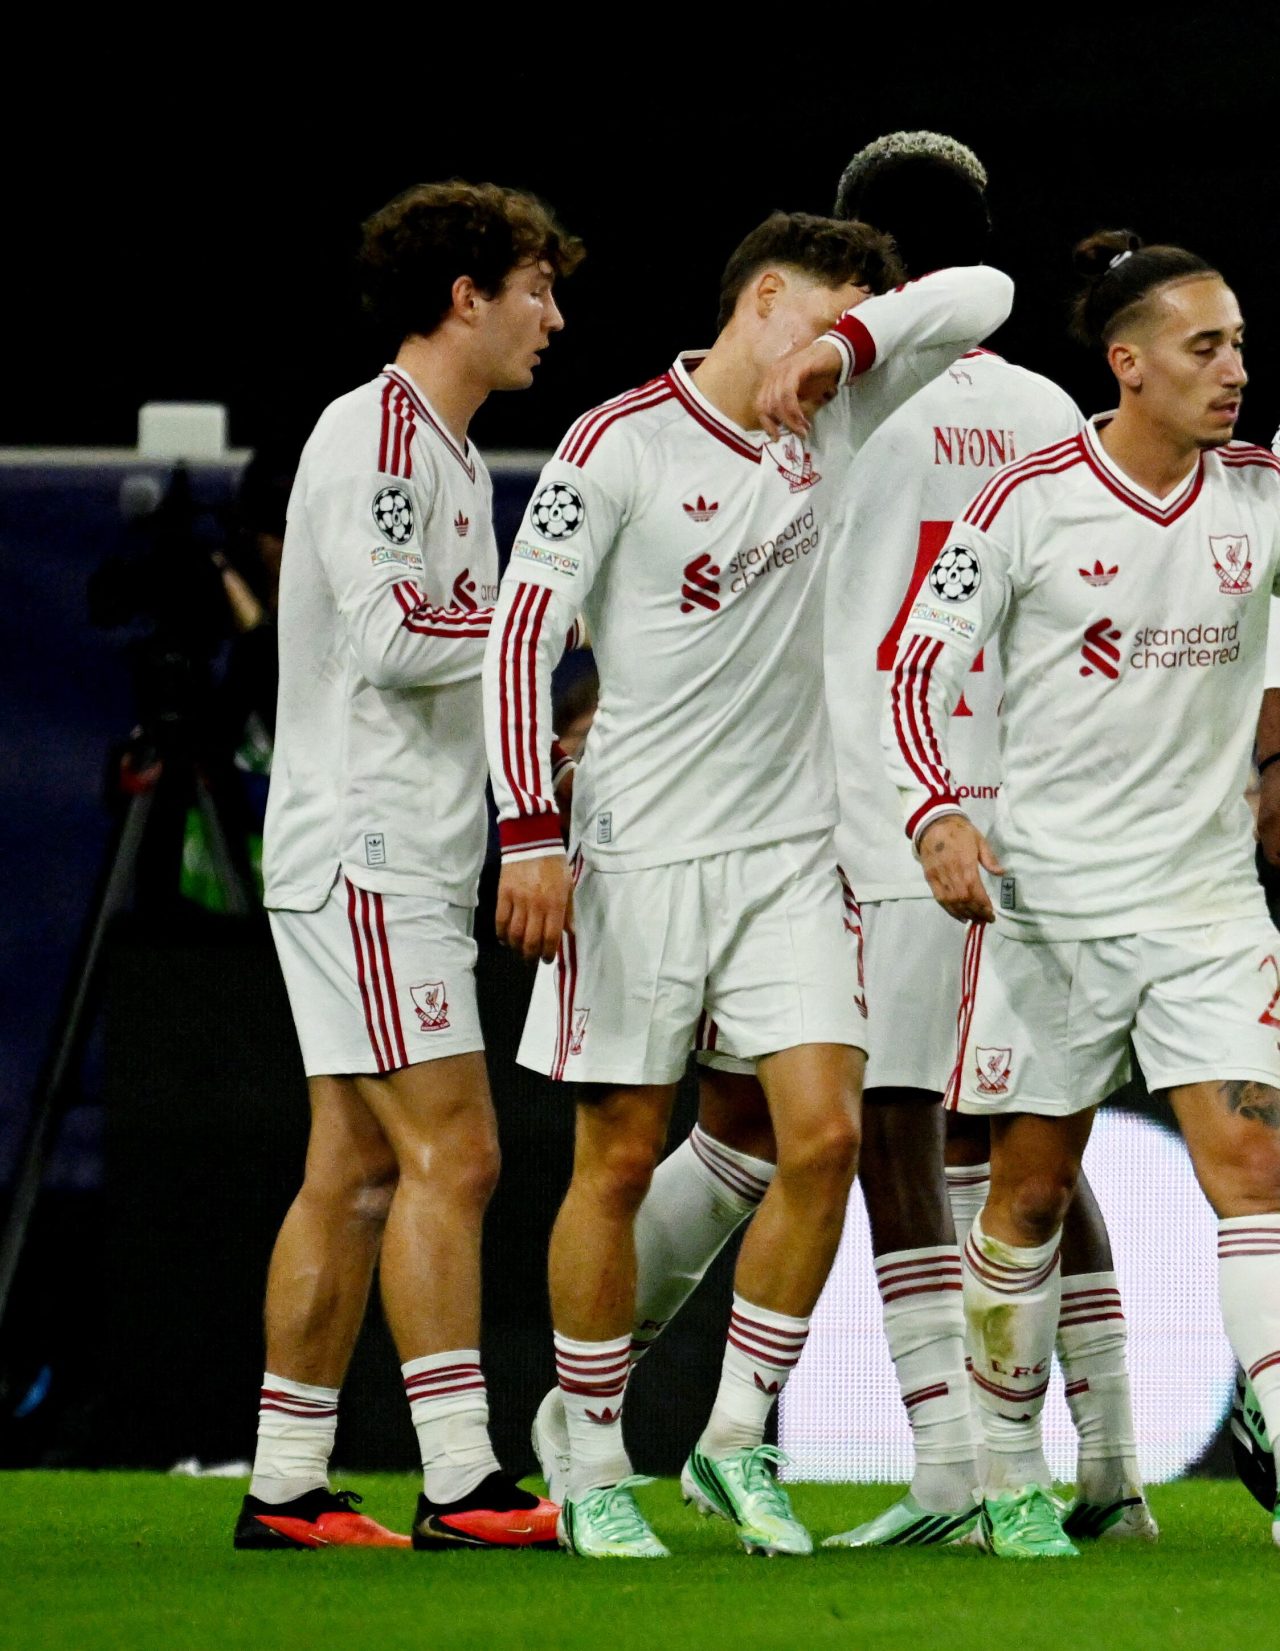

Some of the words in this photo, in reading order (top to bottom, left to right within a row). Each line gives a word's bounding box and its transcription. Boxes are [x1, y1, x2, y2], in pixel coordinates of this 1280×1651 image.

[933, 426, 1015, 467] NYONI
[729, 505, 815, 574] standard
[1134, 620, 1239, 648] standard
[1130, 642, 1240, 669] chartered
[991, 1357, 1047, 1378] LFC
